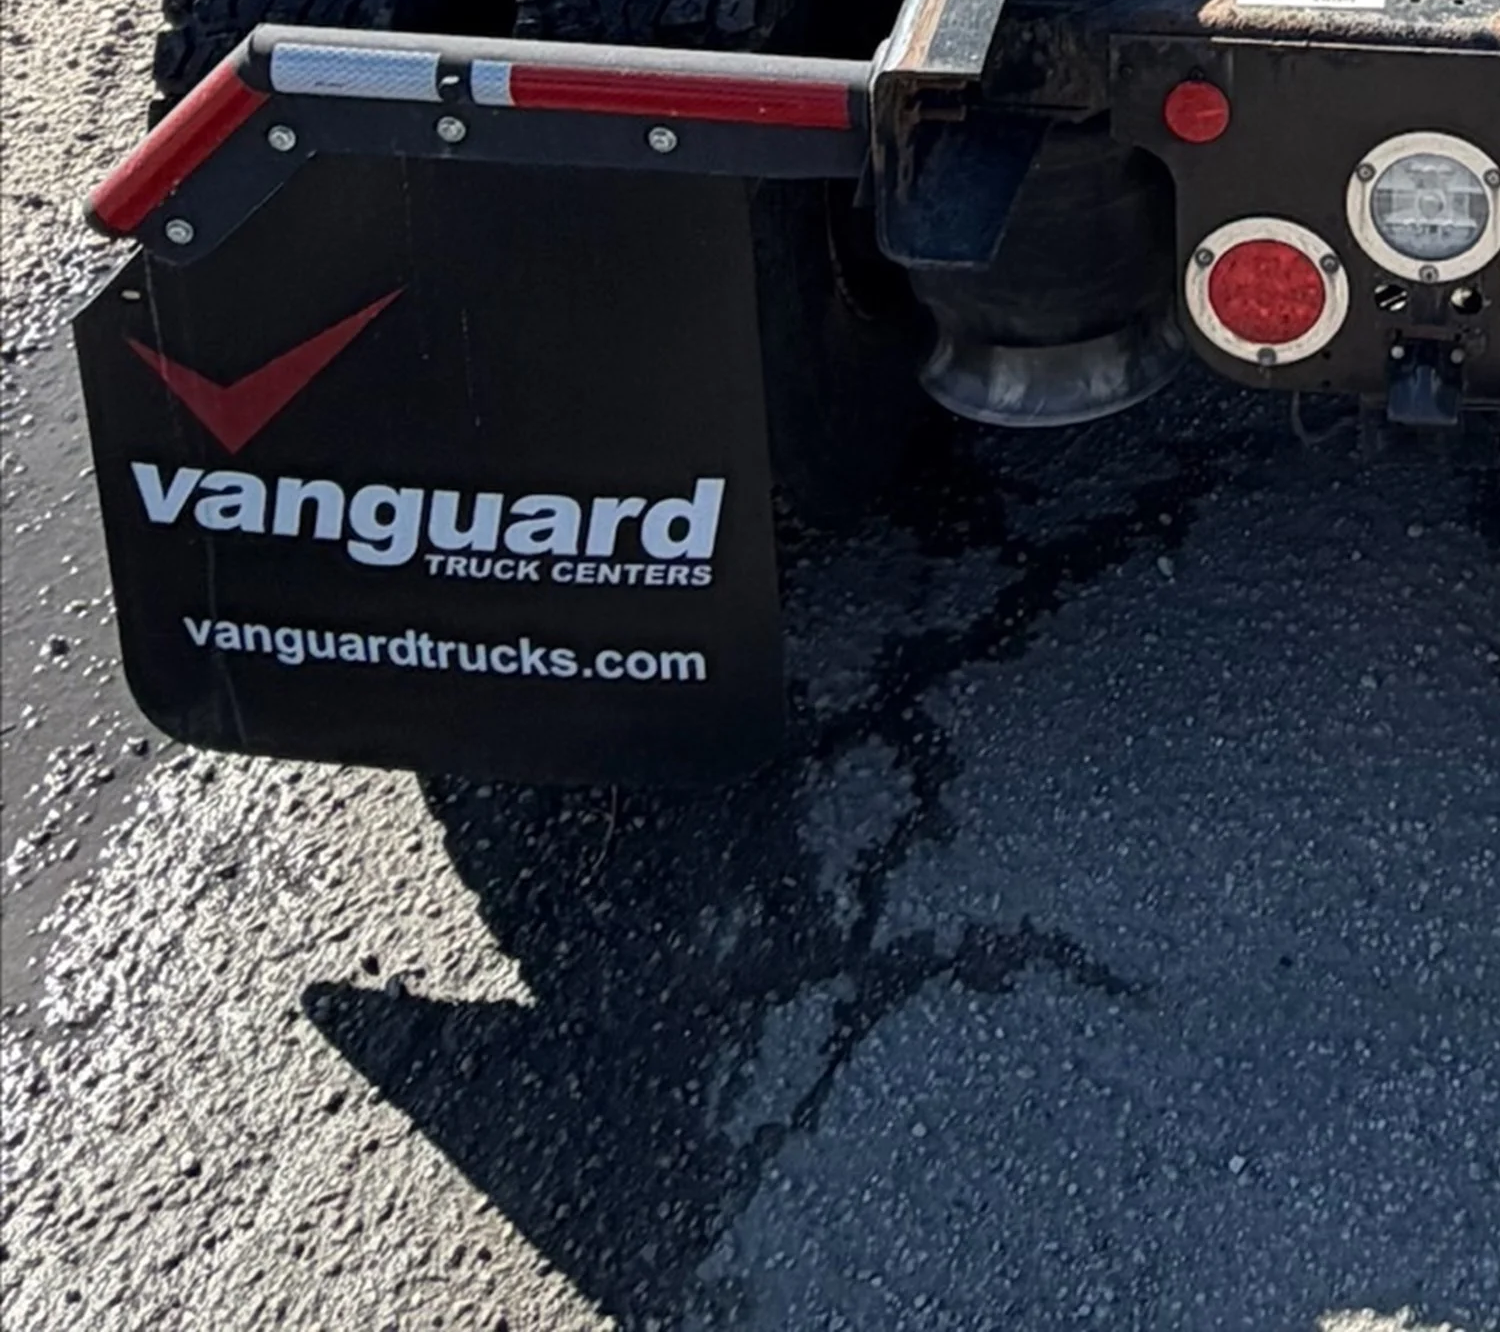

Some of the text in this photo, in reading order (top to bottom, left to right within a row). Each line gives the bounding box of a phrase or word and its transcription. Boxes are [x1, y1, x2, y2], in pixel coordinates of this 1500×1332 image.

[131, 462, 726, 566] vanguard
[425, 554, 713, 587] TRUCK CENTERS
[183, 617, 707, 682] vanguardtrucks.com
